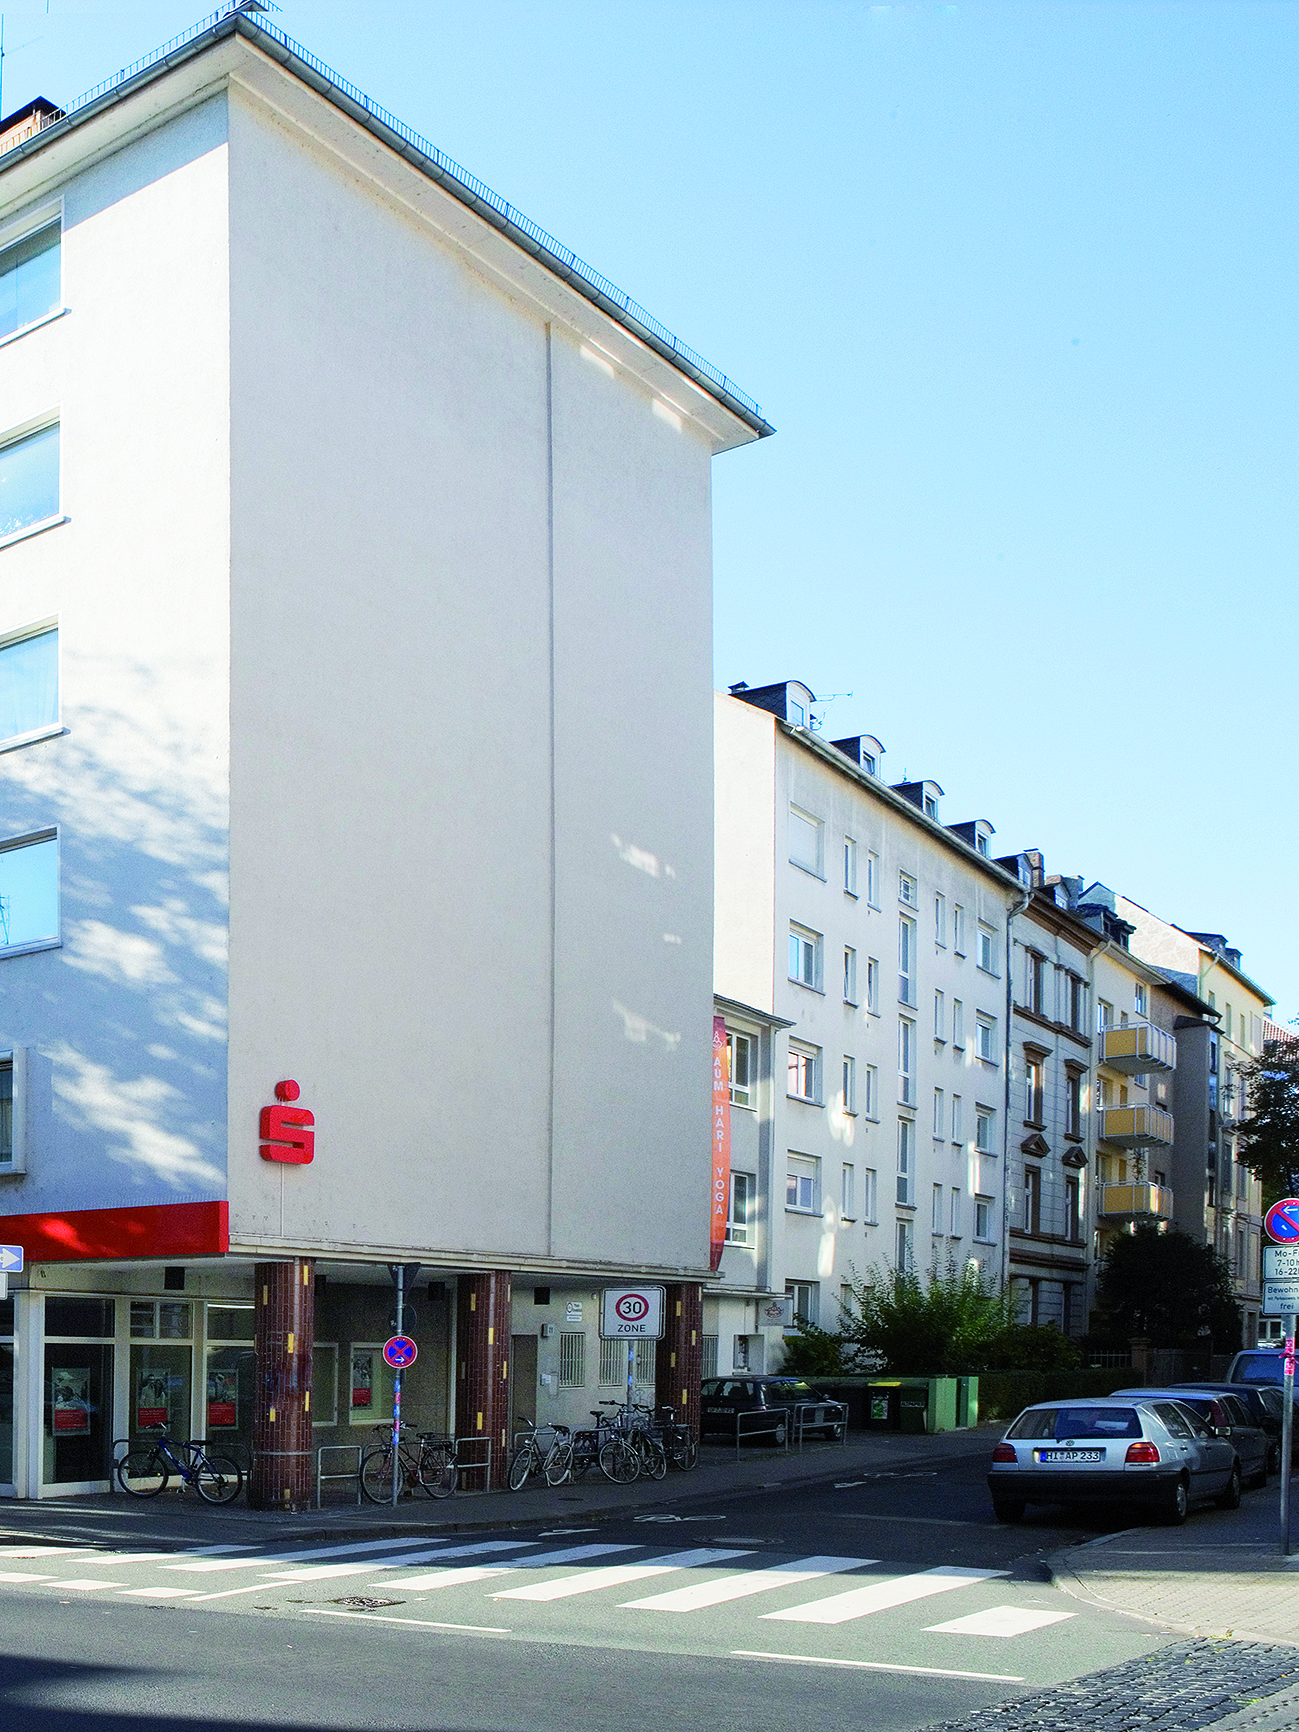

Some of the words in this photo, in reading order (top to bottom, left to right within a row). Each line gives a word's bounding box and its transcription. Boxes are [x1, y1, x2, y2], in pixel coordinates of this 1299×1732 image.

[713, 1056, 724, 1091] AUM
[715, 1105, 725, 1152] HARI
[715, 1167, 725, 1215] YOGA
[1277, 1259, 1295, 1267] 7-10
[1267, 1286, 1299, 1294] Bewohn
[622, 1300, 642, 1315] 30
[1280, 1302, 1294, 1310] frei
[617, 1324, 646, 1333] ZONE
[1046, 1452, 1058, 1460] HI
[1065, 1452, 1078, 1460] AP
[1080, 1452, 1099, 1460] 233
